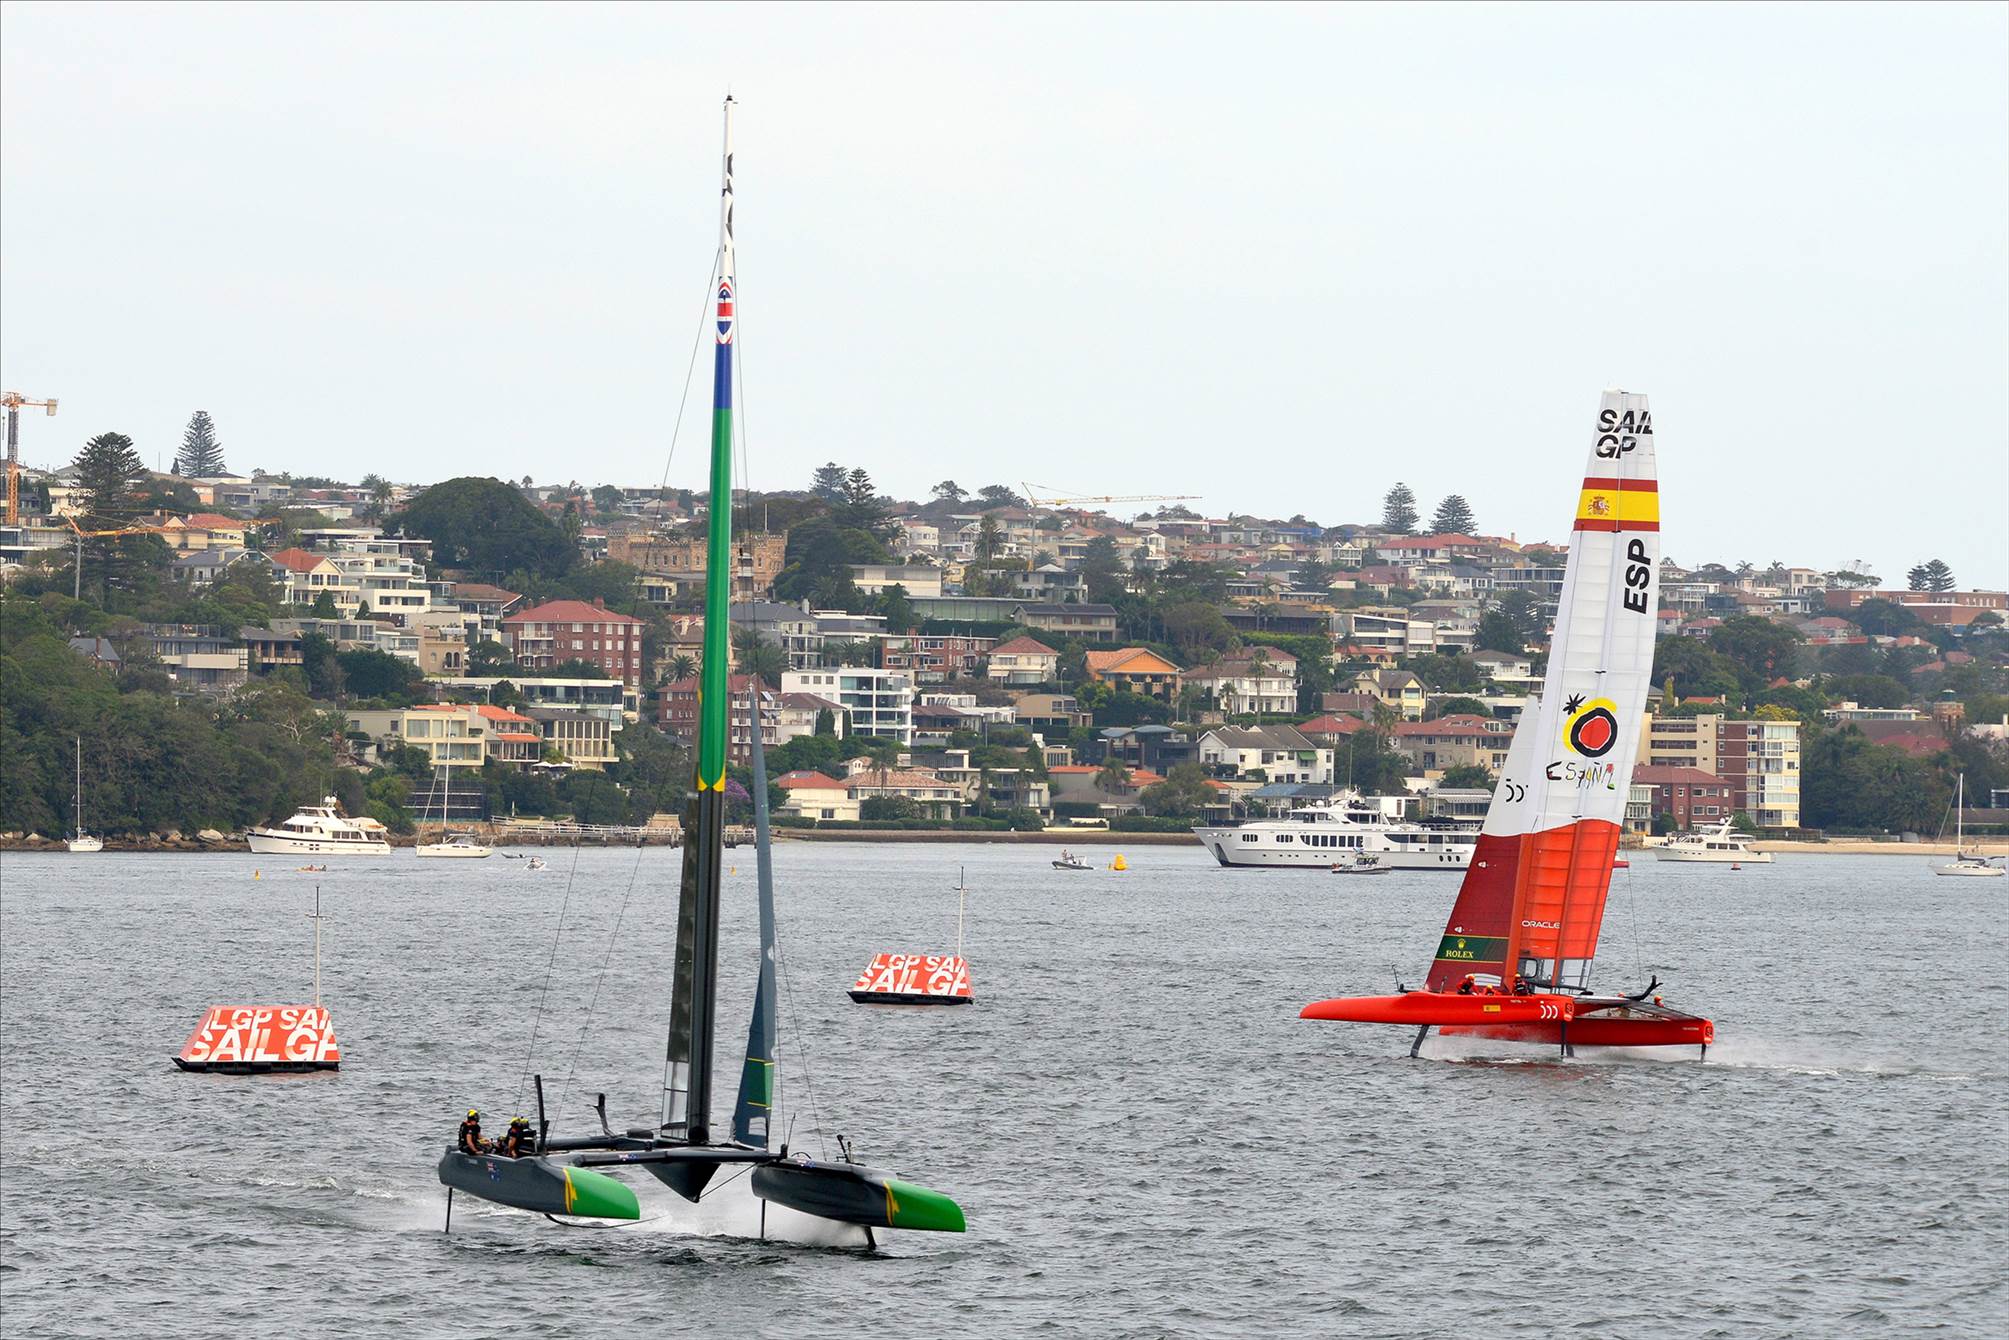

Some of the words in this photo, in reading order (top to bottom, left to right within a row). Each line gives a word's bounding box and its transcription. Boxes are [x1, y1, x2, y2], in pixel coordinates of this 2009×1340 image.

[1597, 409, 1653, 435] SAIL
[1596, 435, 1637, 459] GP
[1623, 538, 1651, 614] ESP
[1521, 920, 1561, 929] ORACLE
[1445, 949, 1474, 959] ROLEX
[853, 968, 923, 994] SAIL
[231, 1008, 273, 1030] GP
[187, 1029, 280, 1062] SAIL
